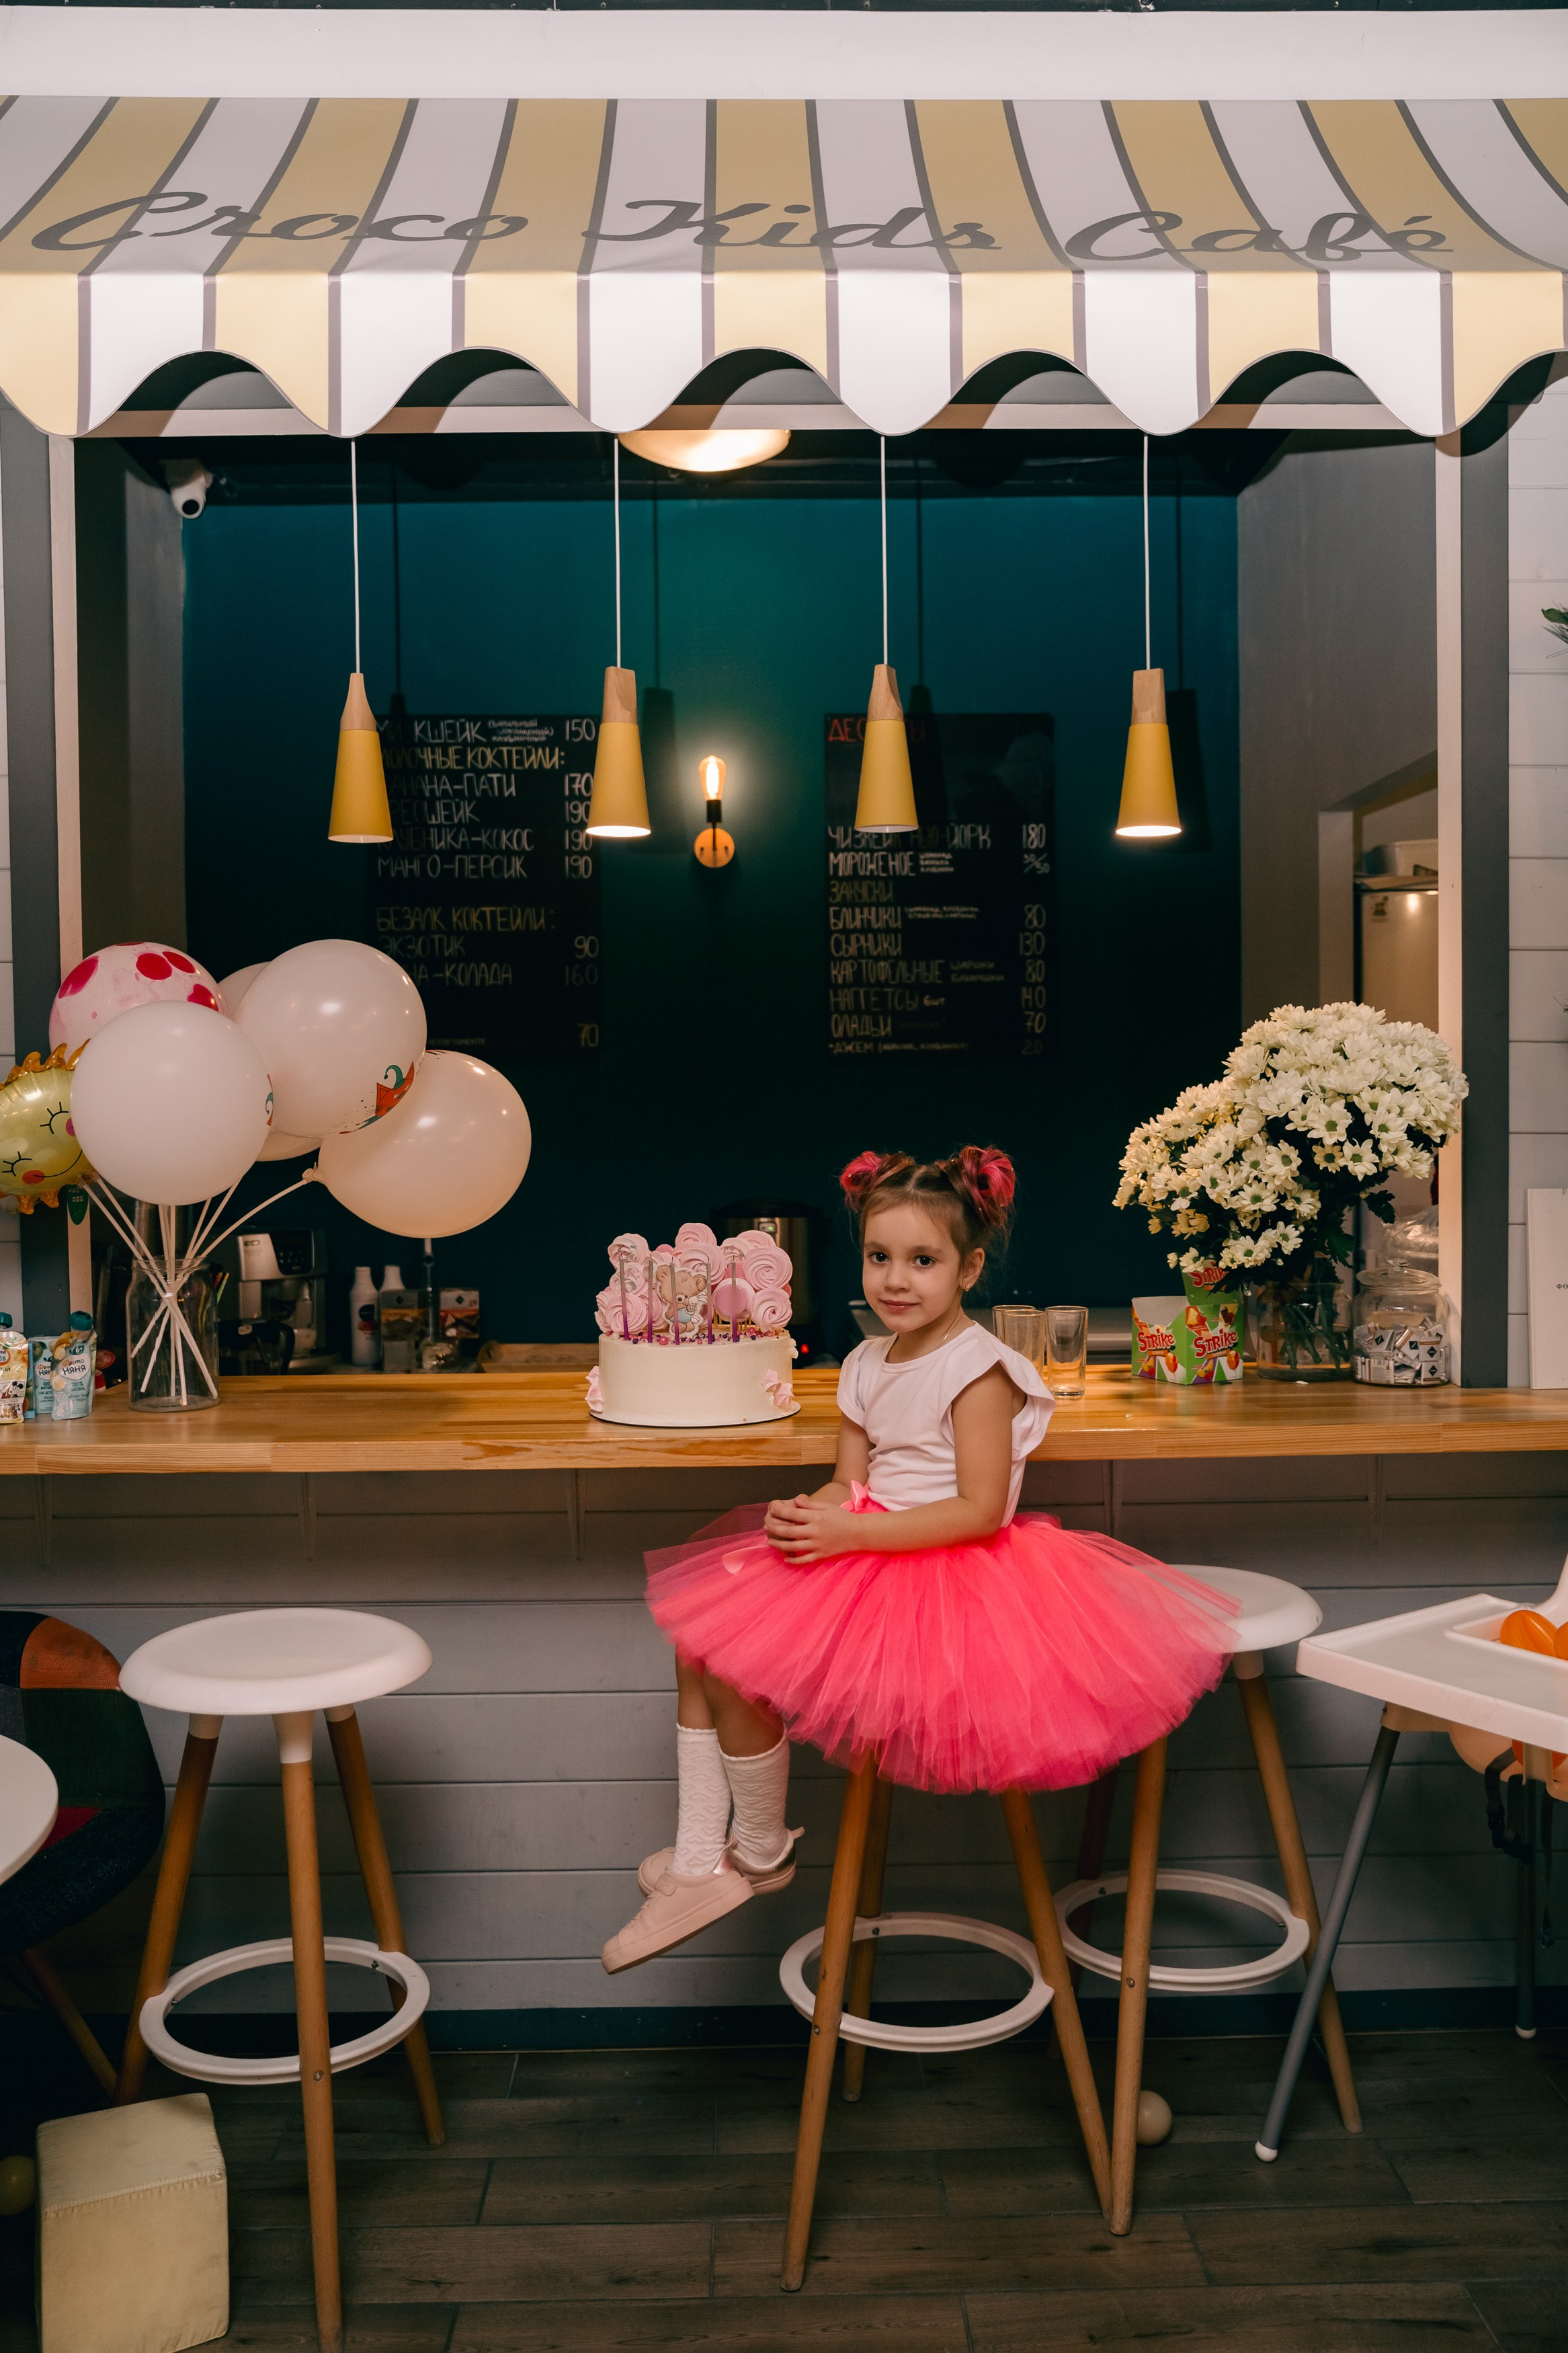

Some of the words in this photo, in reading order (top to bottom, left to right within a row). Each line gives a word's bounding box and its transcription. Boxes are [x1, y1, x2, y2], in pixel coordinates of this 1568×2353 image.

[32, 192, 528, 251] Croco
[581, 199, 1001, 250] Kids
[1066, 210, 1454, 262] Café
[565, 718, 595, 742] 150
[467, 746, 565, 770] КОКТЕЙЛИ:
[388, 772, 516, 797] АНАНА-ПАТИ
[565, 772, 593, 797] 170
[565, 800, 591, 824] 190
[377, 827, 534, 852] ЛУБНИКА-КОКОС
[565, 828, 593, 852] 190
[1022, 823, 1046, 849] 180
[377, 854, 527, 879] МАНГО-ПЕРСИК
[565, 854, 593, 879] 190
[829, 851, 916, 877] МОРОЖЕНОЕ
[828, 879, 894, 904] ЗАКУСКИ
[452, 905, 555, 932] КОКТЕЙЛИ:
[829, 906, 902, 930] БЛИНЧИКИ
[1024, 904, 1046, 929] 80
[378, 934, 466, 959] ЭКЗОТИК
[574, 935, 600, 959] 90
[830, 932, 902, 957] СЫРНИКИ
[1019, 930, 1046, 957] 130
[565, 963, 598, 987] 160
[1025, 958, 1046, 983] 80
[576, 1023, 599, 1047] 70
[831, 1014, 891, 1038] ОЛАДЬИ
[1023, 1010, 1046, 1034] 70
[1020, 1037, 1043, 1055] 20
